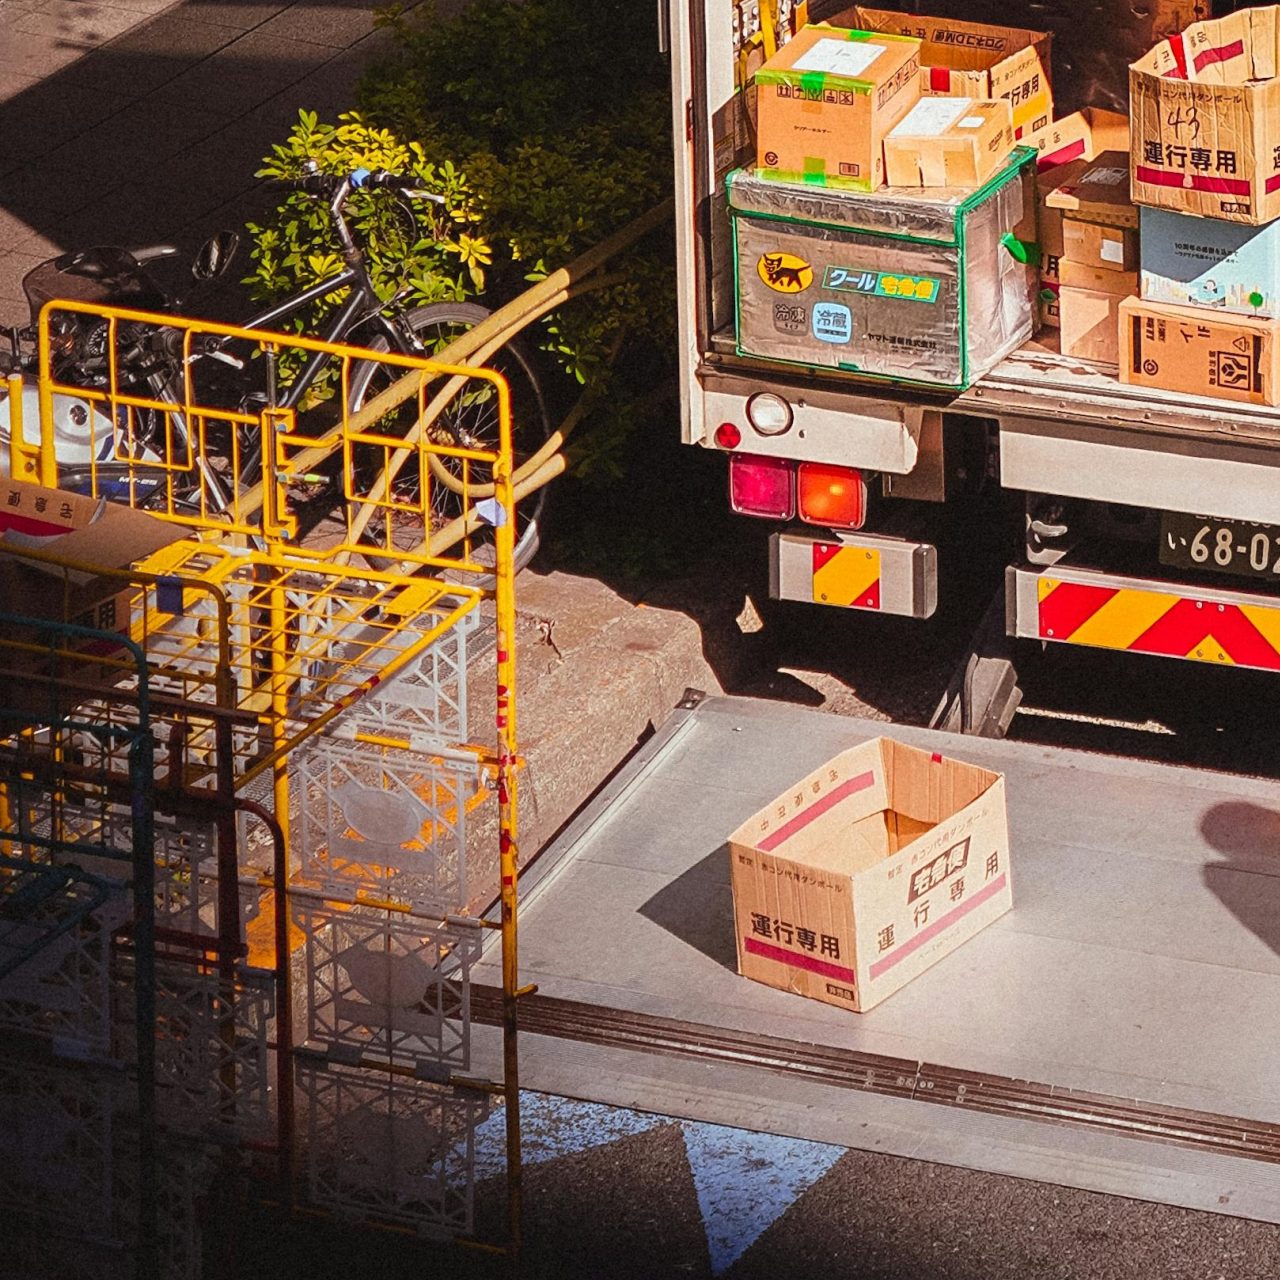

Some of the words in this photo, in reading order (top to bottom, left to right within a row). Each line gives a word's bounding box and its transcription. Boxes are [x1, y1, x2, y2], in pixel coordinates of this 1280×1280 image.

[1167, 106, 1200, 140] 43
[1144, 140, 1237, 174] 運行専用
[1168, 532, 1187, 550] い
[877, 850, 999, 953] 運行専用
[751, 911, 841, 960] 運行専用
